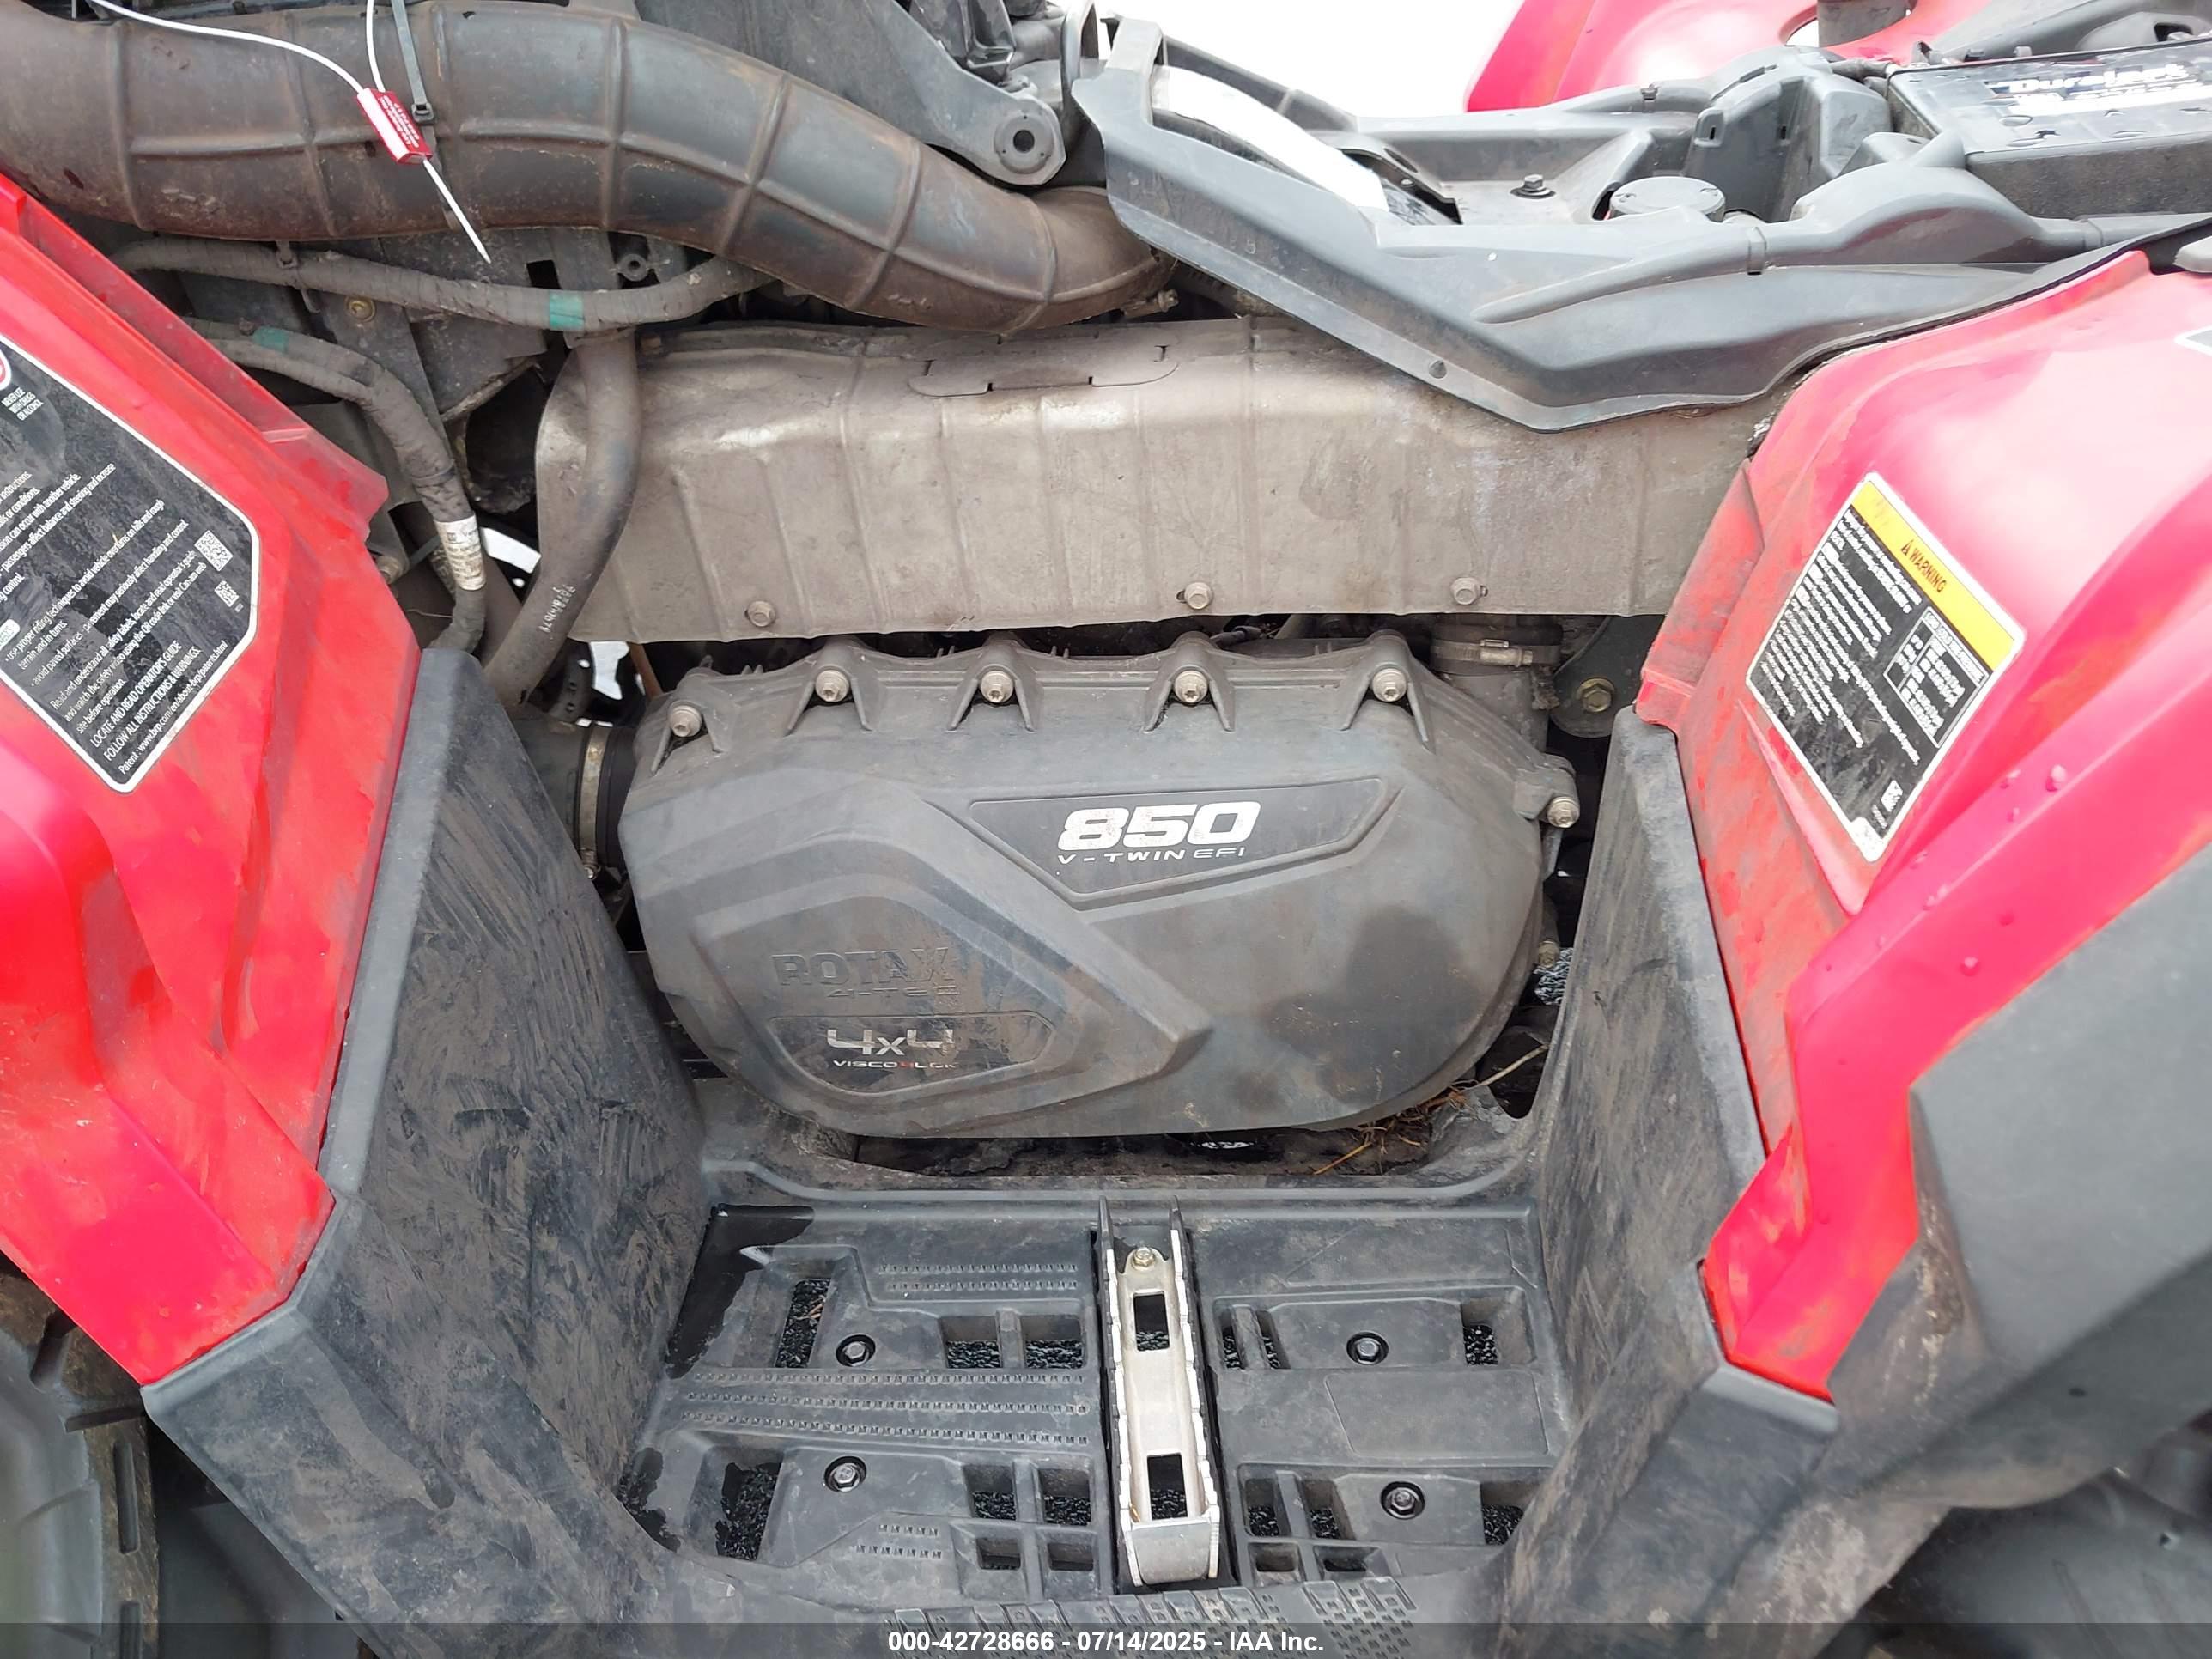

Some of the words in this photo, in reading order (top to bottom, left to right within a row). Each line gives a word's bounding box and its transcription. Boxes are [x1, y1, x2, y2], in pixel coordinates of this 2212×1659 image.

[14, 387, 26, 398] USE
[17, 411, 27, 420] OR
[22, 399, 44, 416] ALCOHOL
[1, 541, 32, 573] passengers
[28, 528, 46, 545] affect
[40, 512, 64, 532] balance
[59, 501, 73, 515] and
[69, 487, 92, 507] steering
[87, 477, 99, 490] and
[94, 463, 116, 483] increase
[5, 509, 14, 518] or
[11, 487, 40, 513] conditions.
[9, 526, 22, 538] can
[19, 514, 35, 530] occur
[31, 503, 46, 518] with
[42, 488, 64, 507] another
[3, 572, 26, 594] control.
[7, 647, 20, 659] use
[16, 629, 36, 653] proper
[33, 615, 52, 634] riding
[46, 589, 76, 618] techniques
[71, 584, 82, 592] to
[78, 568, 94, 586] avoid
[90, 555, 110, 574] vehicle
[126, 528, 136, 538] on
[131, 520, 144, 532] hills
[141, 510, 153, 523] and
[149, 499, 165, 515] rough
[1908, 546, 1948, 593] WARNING
[33, 665, 50, 685] avoid
[46, 649, 64, 672] paved
[61, 631, 83, 655] surfaces
[82, 603, 109, 633] pavement
[105, 593, 119, 607] may
[115, 574, 137, 598] seriously
[133, 561, 149, 578] affect
[143, 544, 167, 565] handling
[162, 533, 174, 547] and
[171, 519, 189, 538] control.
[18, 650, 39, 670] terrain
[35, 637, 48, 653] and
[43, 635, 53, 643] in
[49, 620, 68, 637] turns.
[50, 690, 67, 709] Read
[64, 680, 77, 696] and
[74, 652, 103, 685] understand
[100, 646, 109, 657] all
[105, 632, 123, 650] safety
[117, 618, 137, 635] labels,
[131, 603, 149, 620] locate
[145, 592, 157, 606] and
[154, 581, 167, 597] read
[163, 562, 186, 586] operator's
[64, 706, 77, 721] and
[74, 691, 91, 710] watch
[87, 683, 100, 695] the
[96, 666, 113, 685] safety
[109, 653, 125, 669] video
[122, 639, 139, 656] using
[133, 630, 146, 642] the
[141, 622, 152, 633] QR
[149, 611, 163, 626] code
[157, 602, 171, 614] link
[167, 596, 175, 605] or
[172, 587, 184, 600] visit
[179, 572, 198, 591] Can-am
[76, 721, 88, 734] site
[83, 703, 103, 724] before
[100, 678, 127, 706] operation.
[90, 720, 115, 747] LOCATE
[110, 707, 125, 725] AND
[120, 690, 139, 711] READ
[135, 657, 167, 695] OPERATOR'S
[162, 640, 182, 661] GUIDE
[103, 731, 130, 761] FOLLOW
[125, 720, 140, 736] ALL
[134, 679, 173, 724] INSTRUCTIONS
[118, 751, 139, 775] Patent
[1057, 801, 1261, 850] 850
[1194, 846, 1245, 860] EFI
[771, 946, 955, 986] ROTAX
[827, 1029, 956, 1056] 4x4
